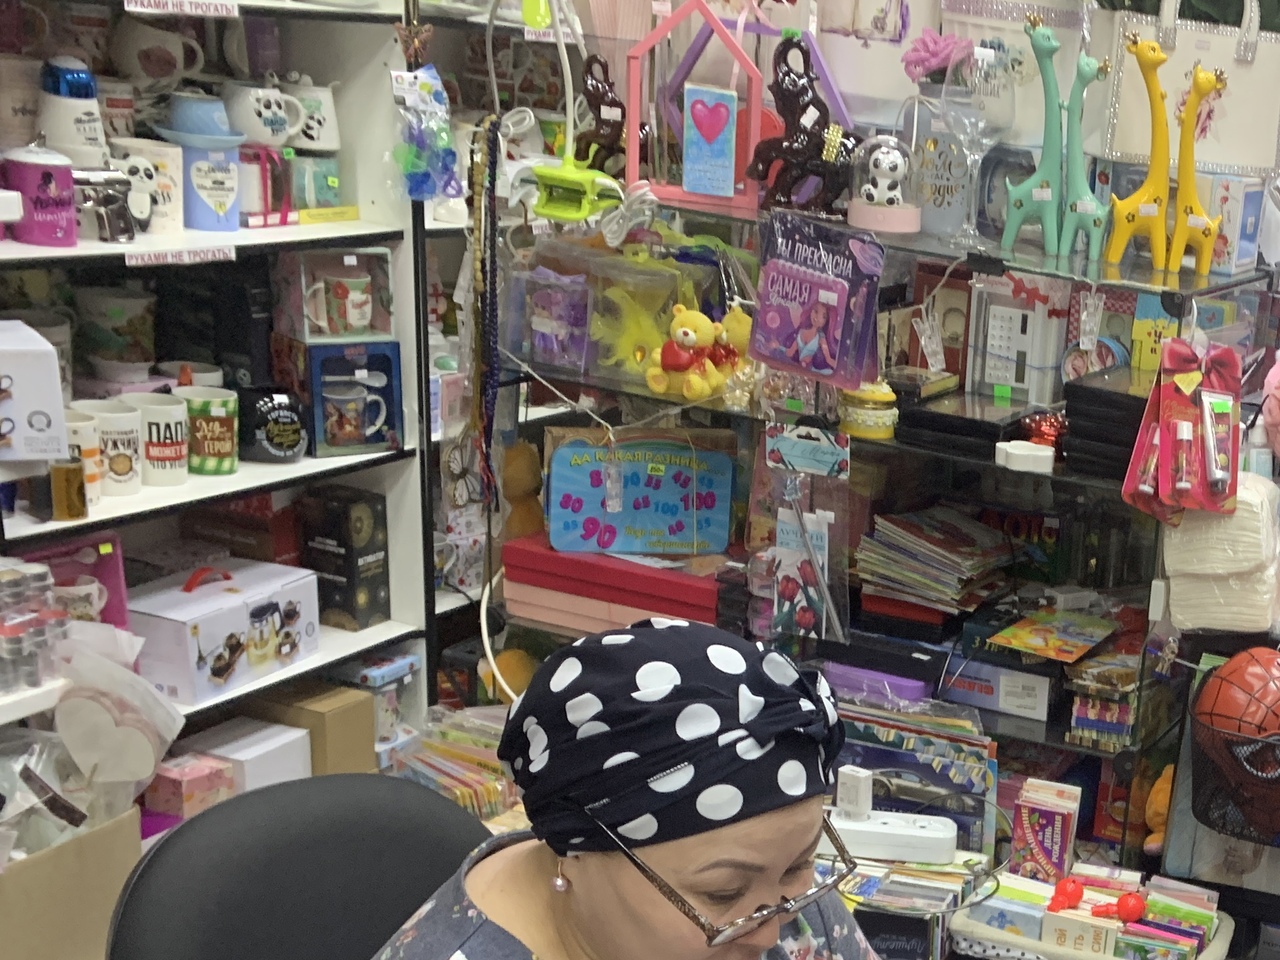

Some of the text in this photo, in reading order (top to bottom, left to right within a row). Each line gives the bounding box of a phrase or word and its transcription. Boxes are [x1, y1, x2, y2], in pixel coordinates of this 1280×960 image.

[126, 0, 235, 15] РУКАМИ НЕ ТРОГАТЬ!
[127, 248, 232, 265] РУКАМИ НЕ ТРОГАТЬ!
[794, 242, 853, 278] ПРЕКРАСНА
[768, 272, 811, 303] САМАЯ
[570, 453, 592, 467] ДА
[595, 450, 642, 462] КАКАЯ
[653, 501, 680, 517] 100
[680, 491, 717, 512] 100
[580, 516, 618, 549] 90
[1021, 806, 1056, 876] ПРИГЛАШЕНИЕ
[1044, 826, 1053, 850] ДЕНЬ
[1052, 815, 1062, 863] РОЖДЕНИЯ
